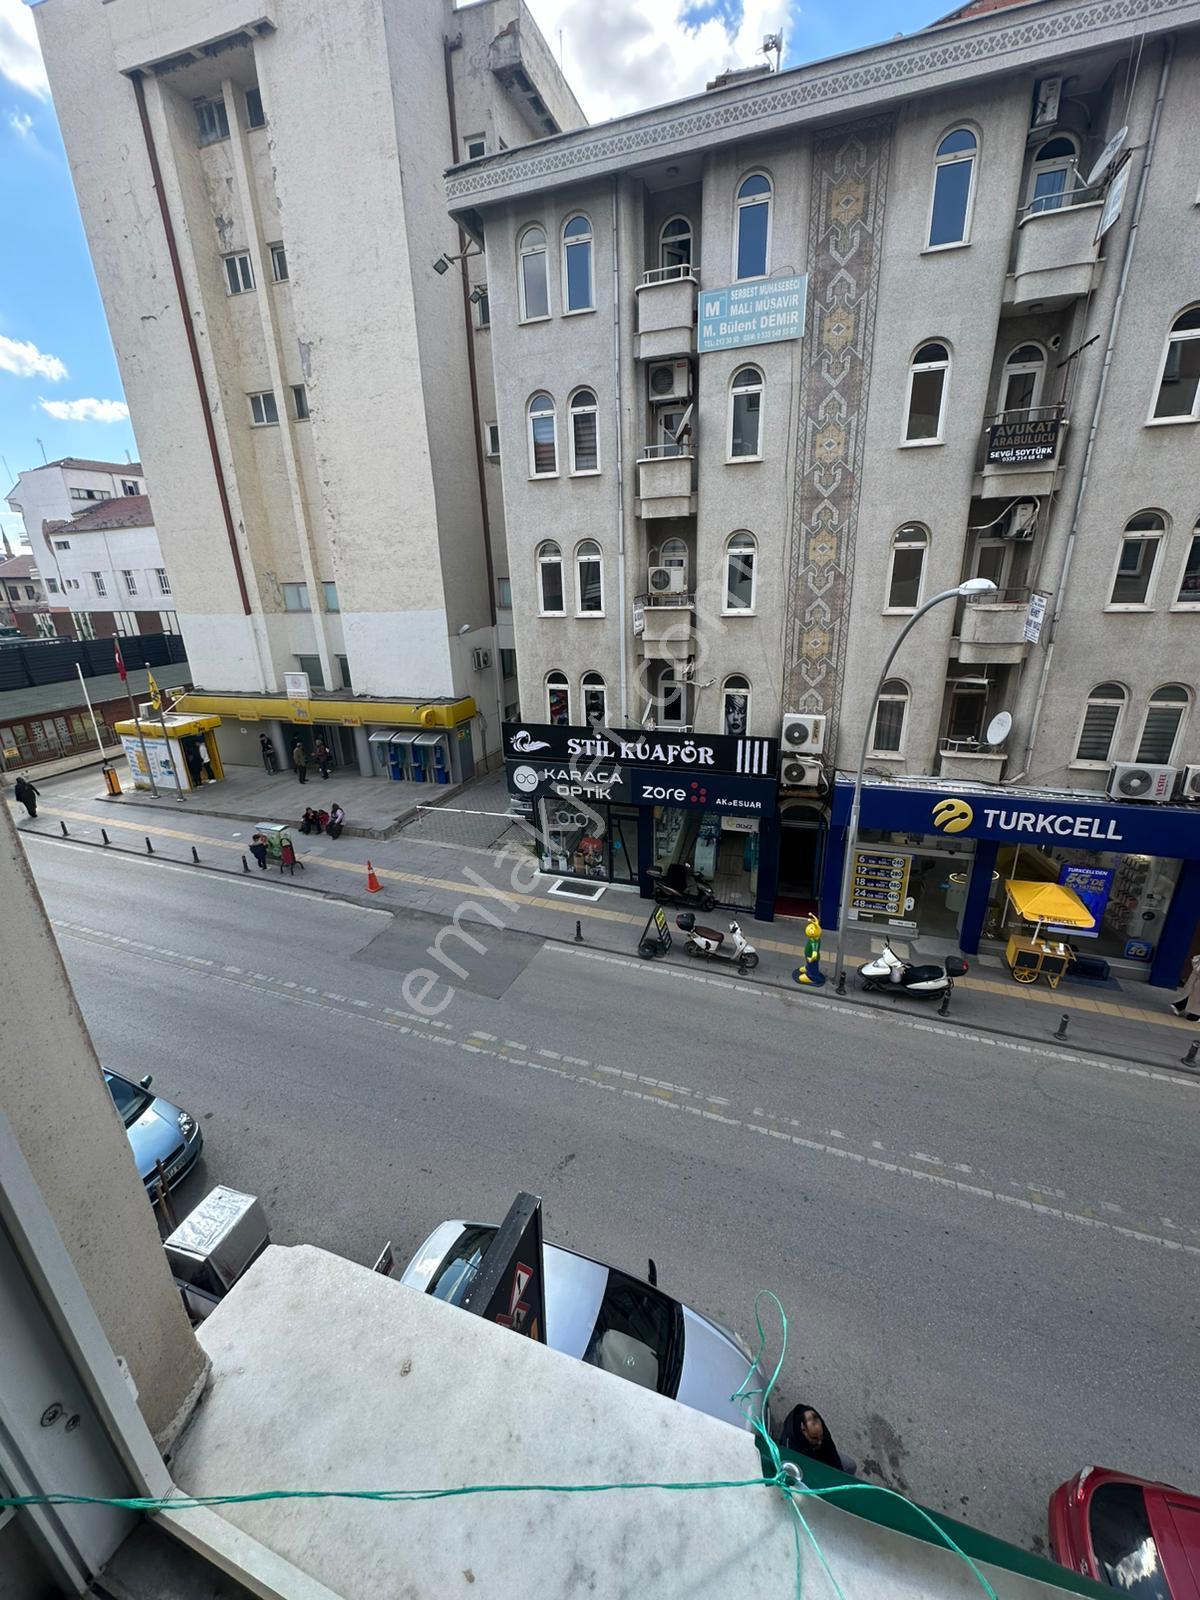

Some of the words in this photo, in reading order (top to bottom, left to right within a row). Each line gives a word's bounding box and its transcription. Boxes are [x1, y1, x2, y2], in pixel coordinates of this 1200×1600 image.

[730, 287, 758, 300] SERBEST
[704, 324, 716, 337] M.
[720, 318, 757, 335] Bülent
[996, 422, 1054, 436] AVUKAT
[992, 432, 1056, 447] ARABULUCU
[990, 448, 1014, 458] SEVGİ
[1016, 446, 1052, 457] SOYTÜRK
[568, 734, 616, 758] STİL
[620, 740, 714, 764] KUAFÖR
[544, 768, 623, 784] KARACA
[556, 785, 612, 800] OPTİK
[984, 810, 1122, 840] TURKCELL
